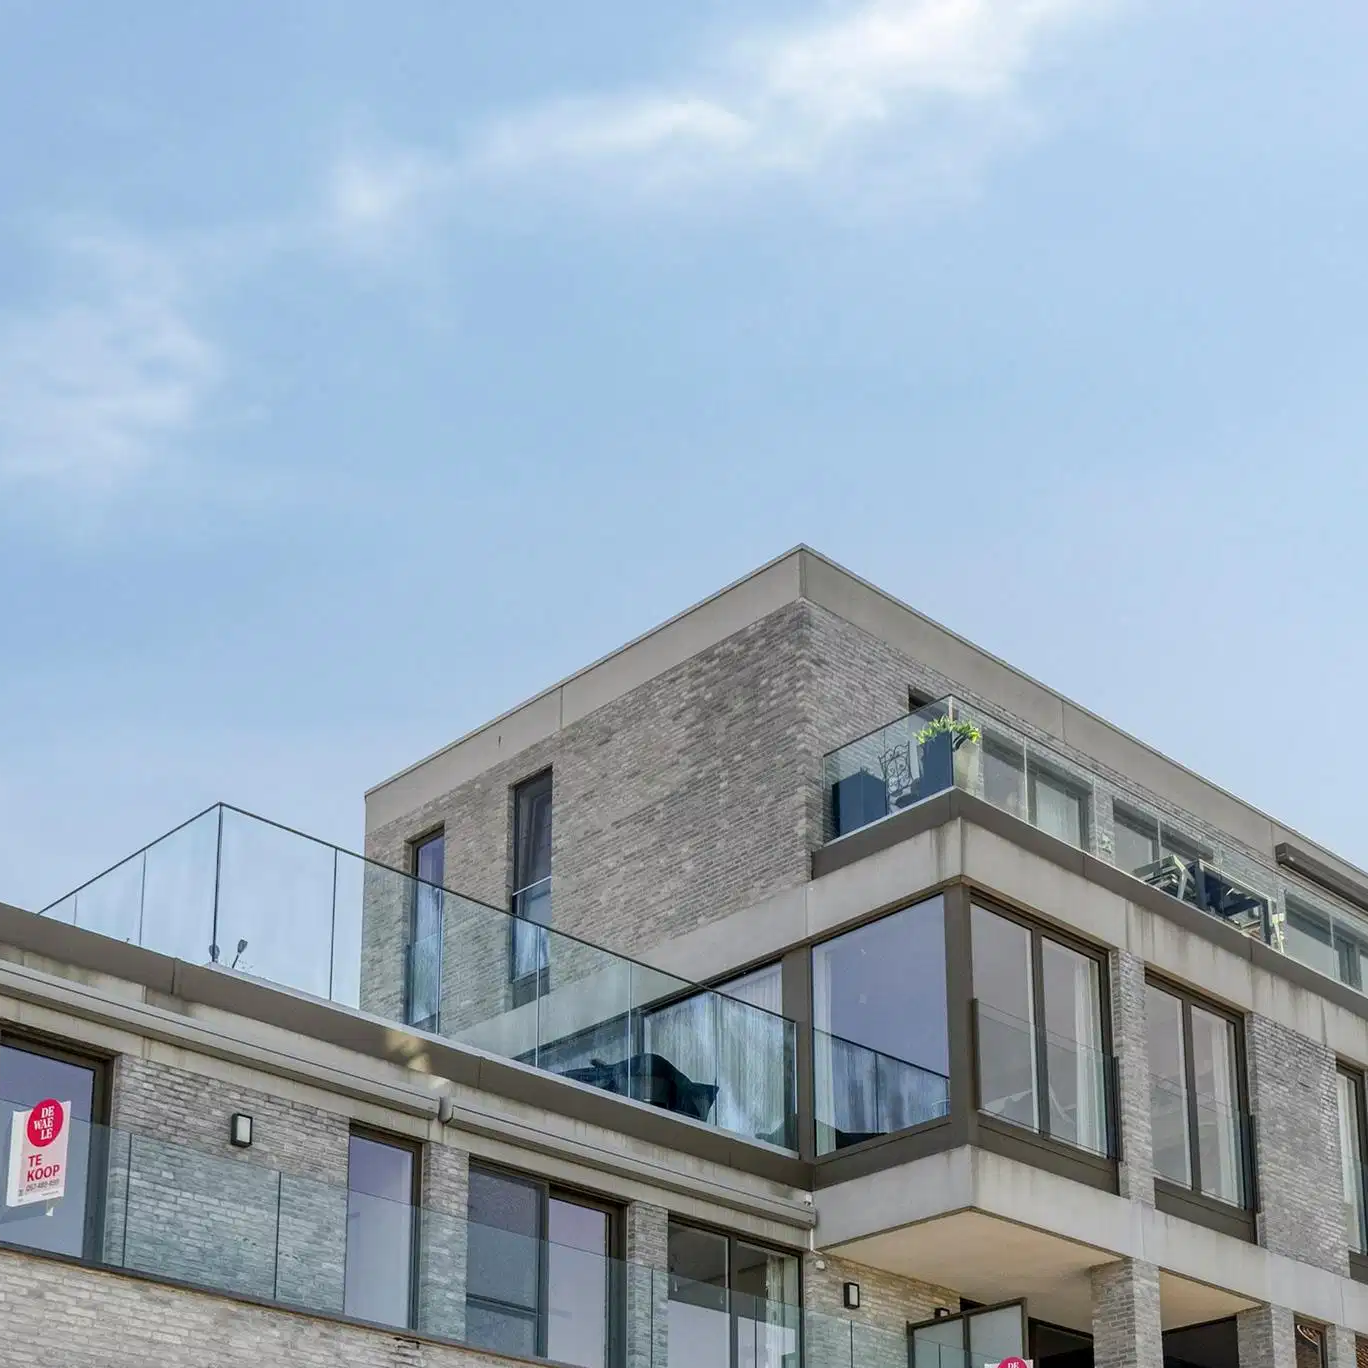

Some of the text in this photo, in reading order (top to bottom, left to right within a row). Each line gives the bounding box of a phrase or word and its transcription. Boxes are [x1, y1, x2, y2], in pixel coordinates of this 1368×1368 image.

[41, 1106, 54, 1118] DE
[34, 1117, 53, 1130] WAE
[41, 1128, 52, 1140] LE
[27, 1153, 42, 1167] TE
[27, 1165, 60, 1181] KOOP
